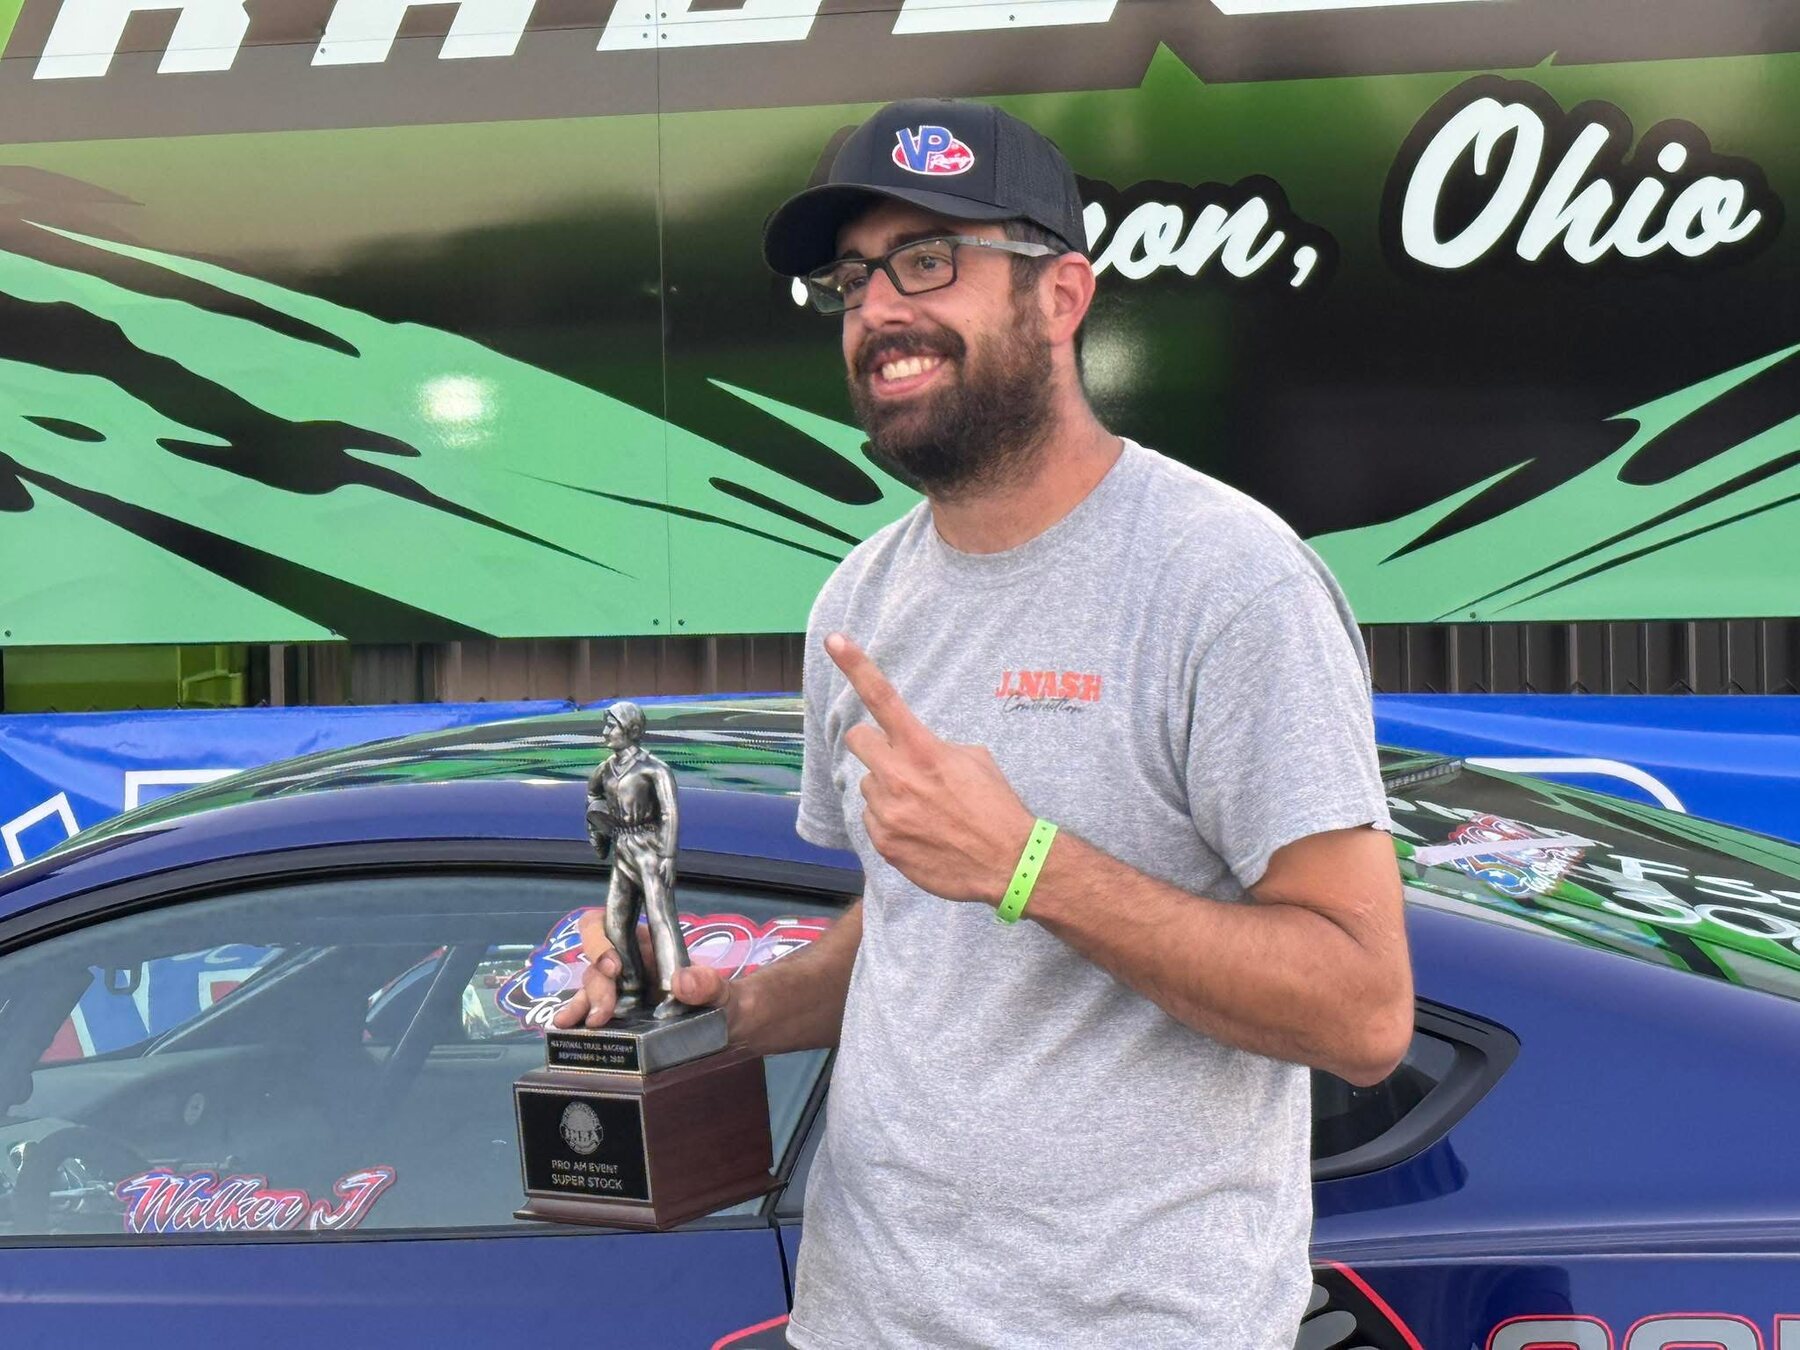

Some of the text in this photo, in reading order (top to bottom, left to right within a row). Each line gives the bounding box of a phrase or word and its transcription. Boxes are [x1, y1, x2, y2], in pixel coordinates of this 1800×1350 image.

[896, 125, 953, 173] VP
[1401, 97, 1761, 269] Ohio
[551, 1160, 618, 1174] PRO AM EVENT
[551, 1174, 623, 1190] SUPER STOCK
[118, 1171, 305, 1234] Walker
